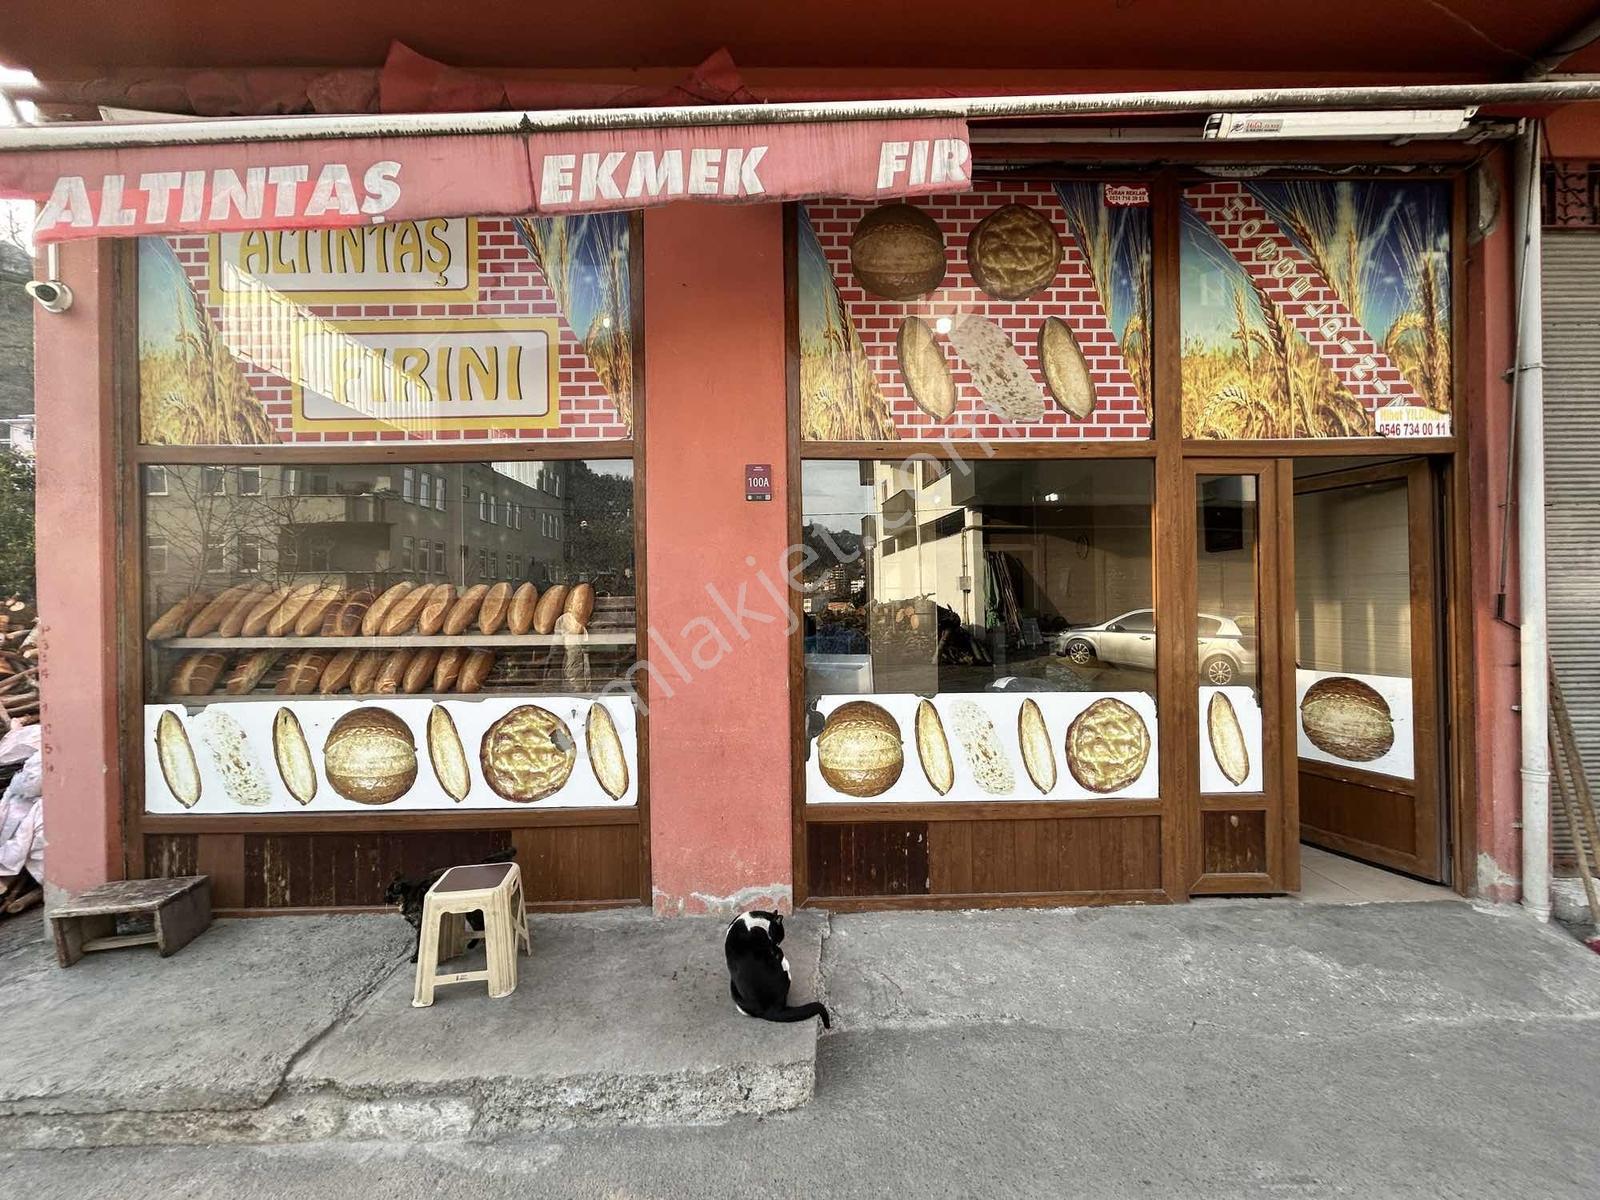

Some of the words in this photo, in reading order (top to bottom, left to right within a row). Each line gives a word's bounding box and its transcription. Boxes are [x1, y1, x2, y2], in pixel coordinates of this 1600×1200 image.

[34, 161, 401, 224] ALTINTAŞ
[540, 146, 768, 205] EKMEK
[239, 216, 451, 287] ALTINTAŞ
[334, 345, 523, 404] FIRINI
[1379, 423, 1401, 437] 0546
[1403, 422, 1420, 436] 734
[1422, 422, 1433, 436] 00
[1436, 421, 1447, 435] 11
[748, 476, 771, 488] 100A
